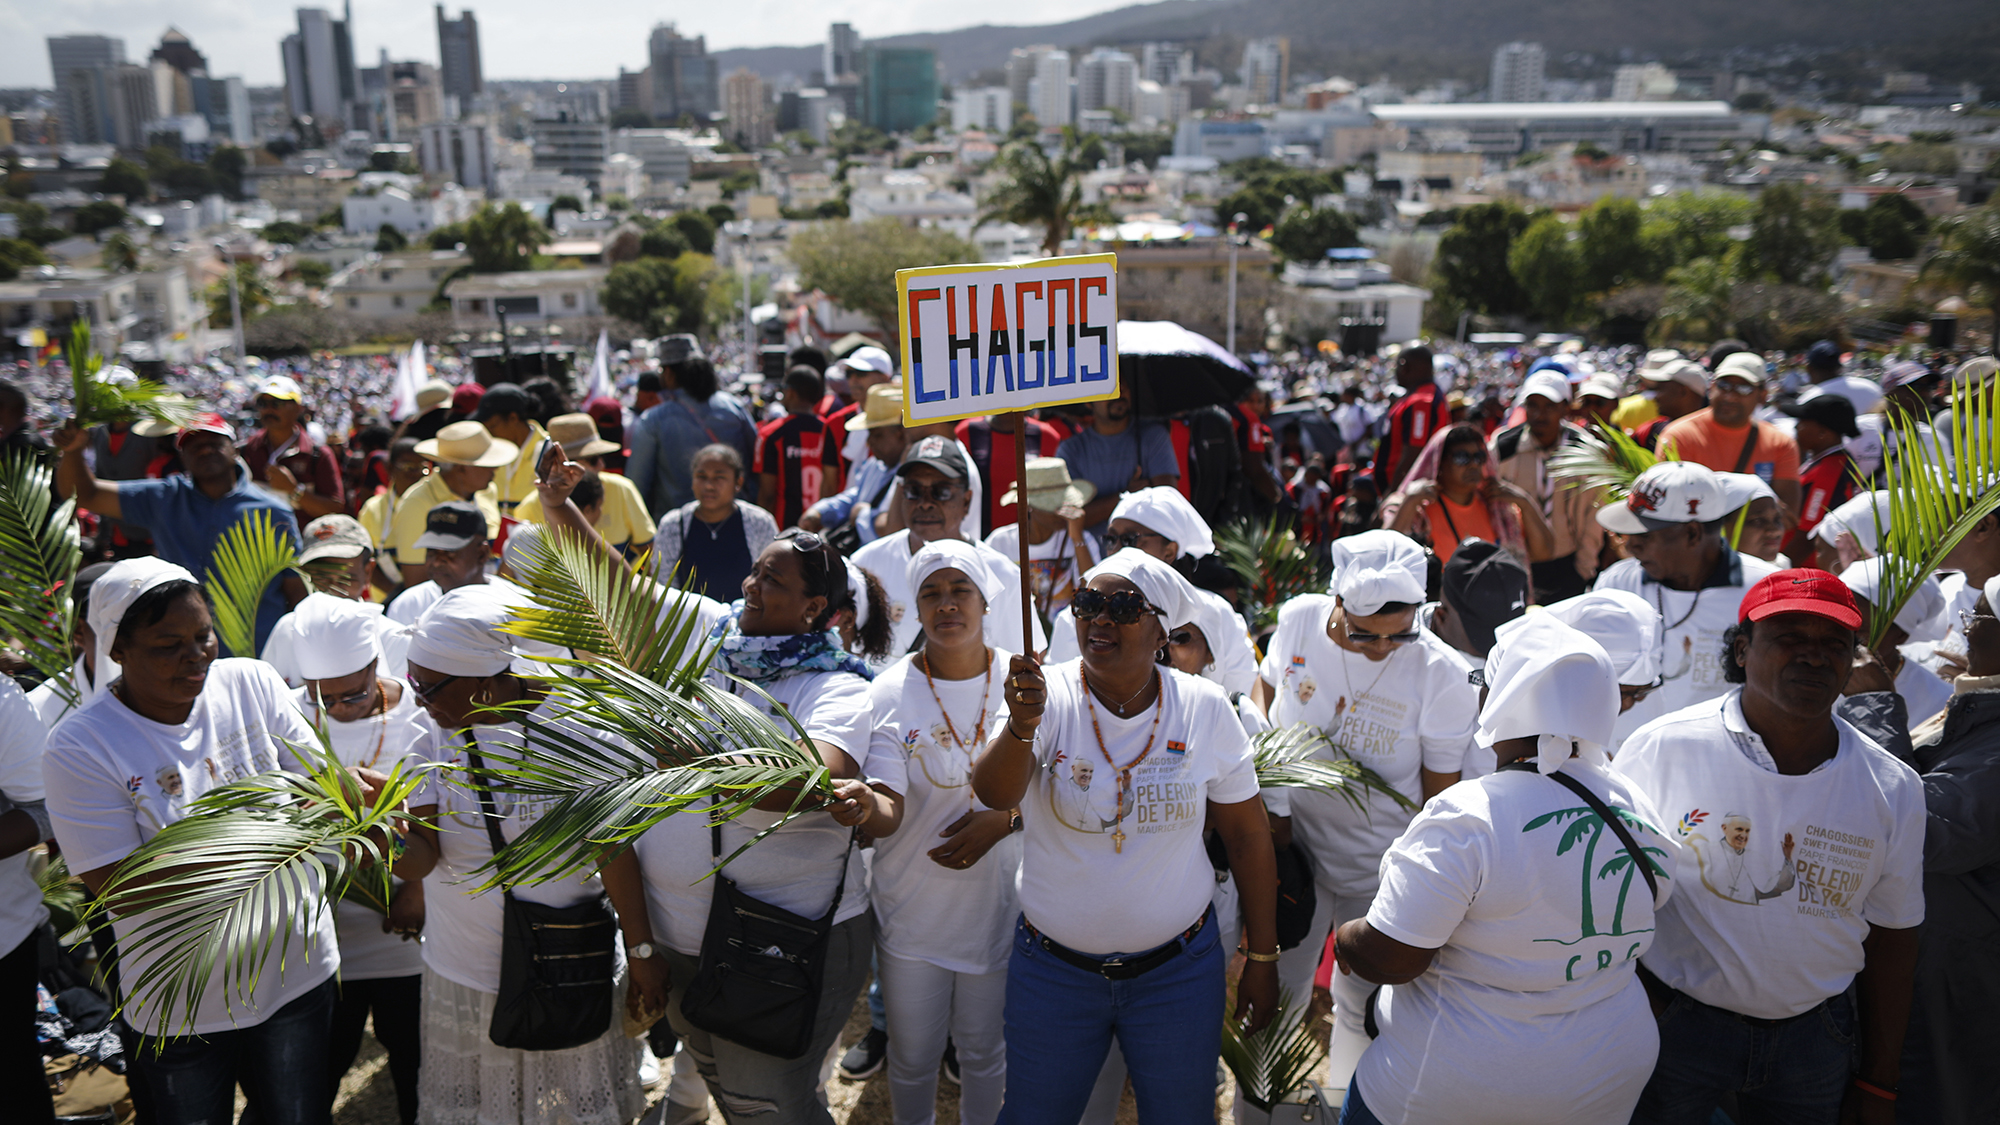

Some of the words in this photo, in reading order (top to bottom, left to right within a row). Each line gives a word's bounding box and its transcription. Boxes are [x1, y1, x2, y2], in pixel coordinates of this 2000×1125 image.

[908, 276, 1109, 404] CHAGOS
[1340, 732, 1359, 751] DE
[1362, 737, 1396, 756] PAIX
[1137, 767, 1156, 775] SWET
[1137, 782, 1197, 803] PÈLERIN
[519, 804, 537, 822] DE
[1137, 804, 1158, 824] DE
[1165, 800, 1197, 822] PAIX
[1137, 824, 1177, 834] MAURICE
[1806, 825, 1875, 849] CHAGOSSIENS
[1799, 848, 1825, 862] PAPE
[1827, 855, 1868, 870] FRANÇOIS
[1803, 837, 1829, 850] SWET
[1830, 844, 1872, 860] BIENVENUE
[1796, 859, 1864, 892] PÈLERIN
[1799, 881, 1820, 904] DE
